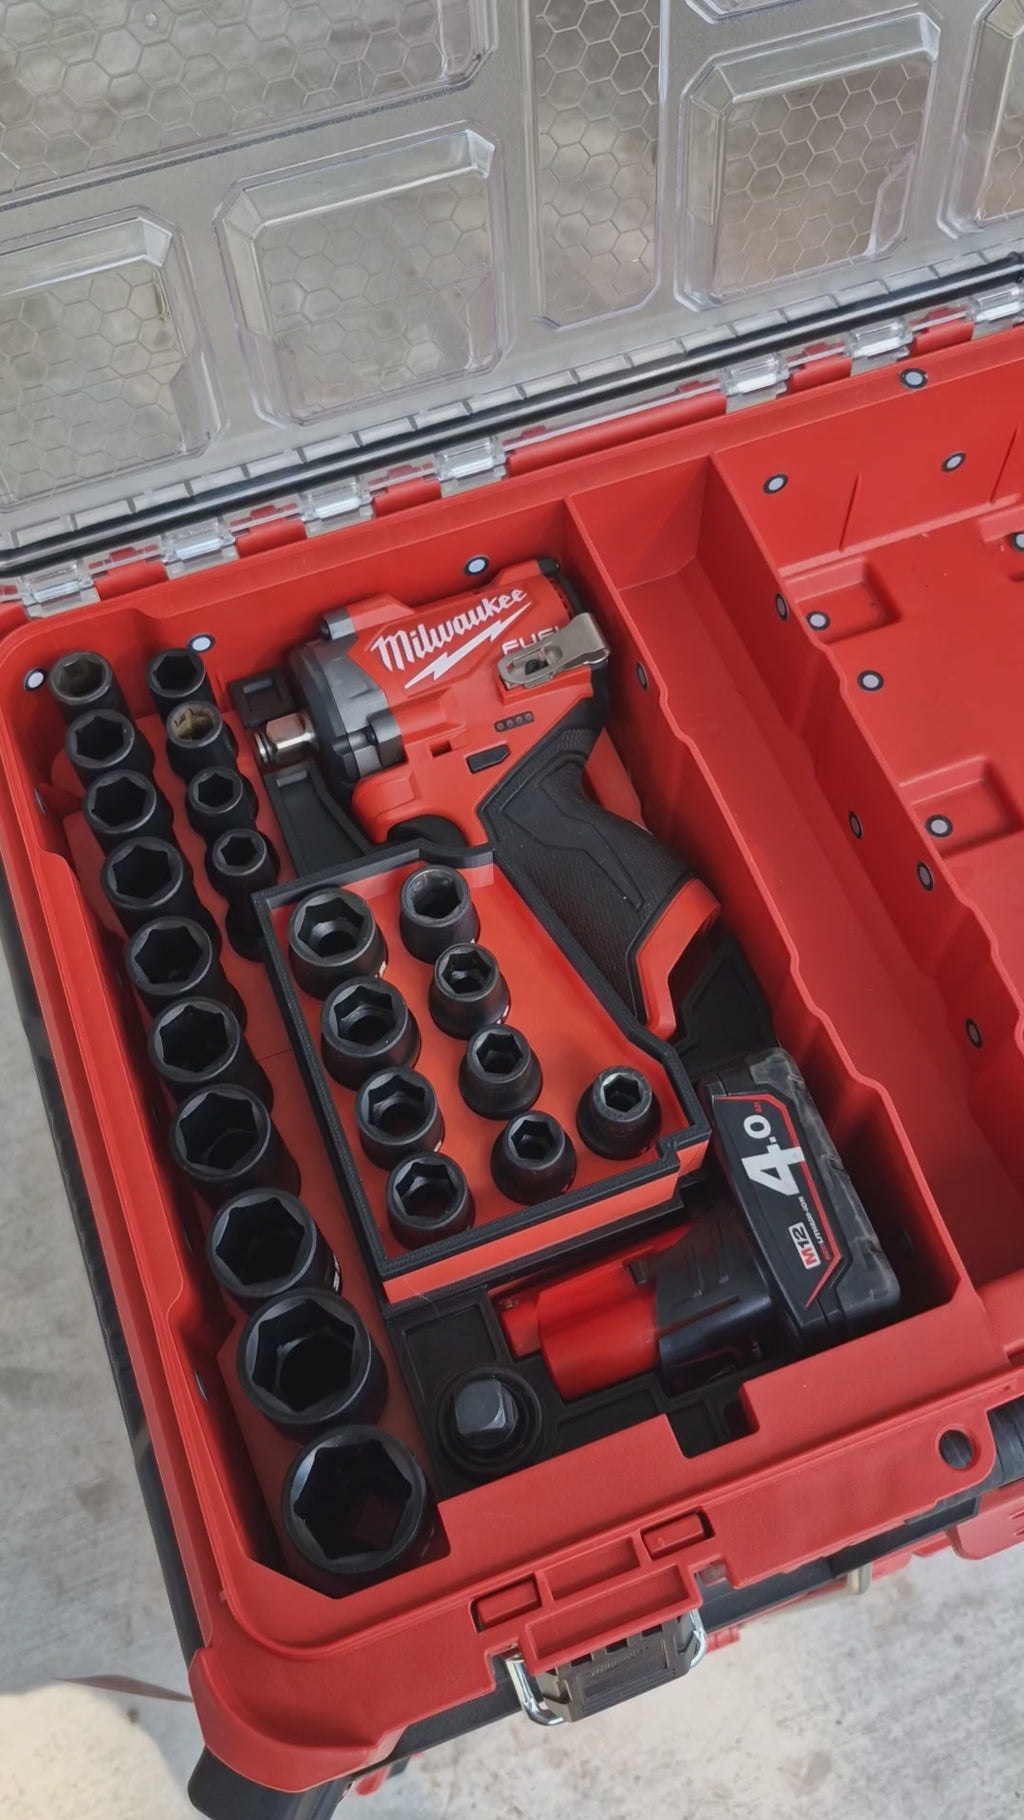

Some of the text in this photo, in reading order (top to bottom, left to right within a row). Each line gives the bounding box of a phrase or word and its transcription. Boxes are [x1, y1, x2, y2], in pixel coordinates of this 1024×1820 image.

[370, 588, 528, 673] Milwaukee
[502, 625, 561, 656] FUE
[741, 1114, 806, 1197] 4.0
[791, 1224, 819, 1268] M12
